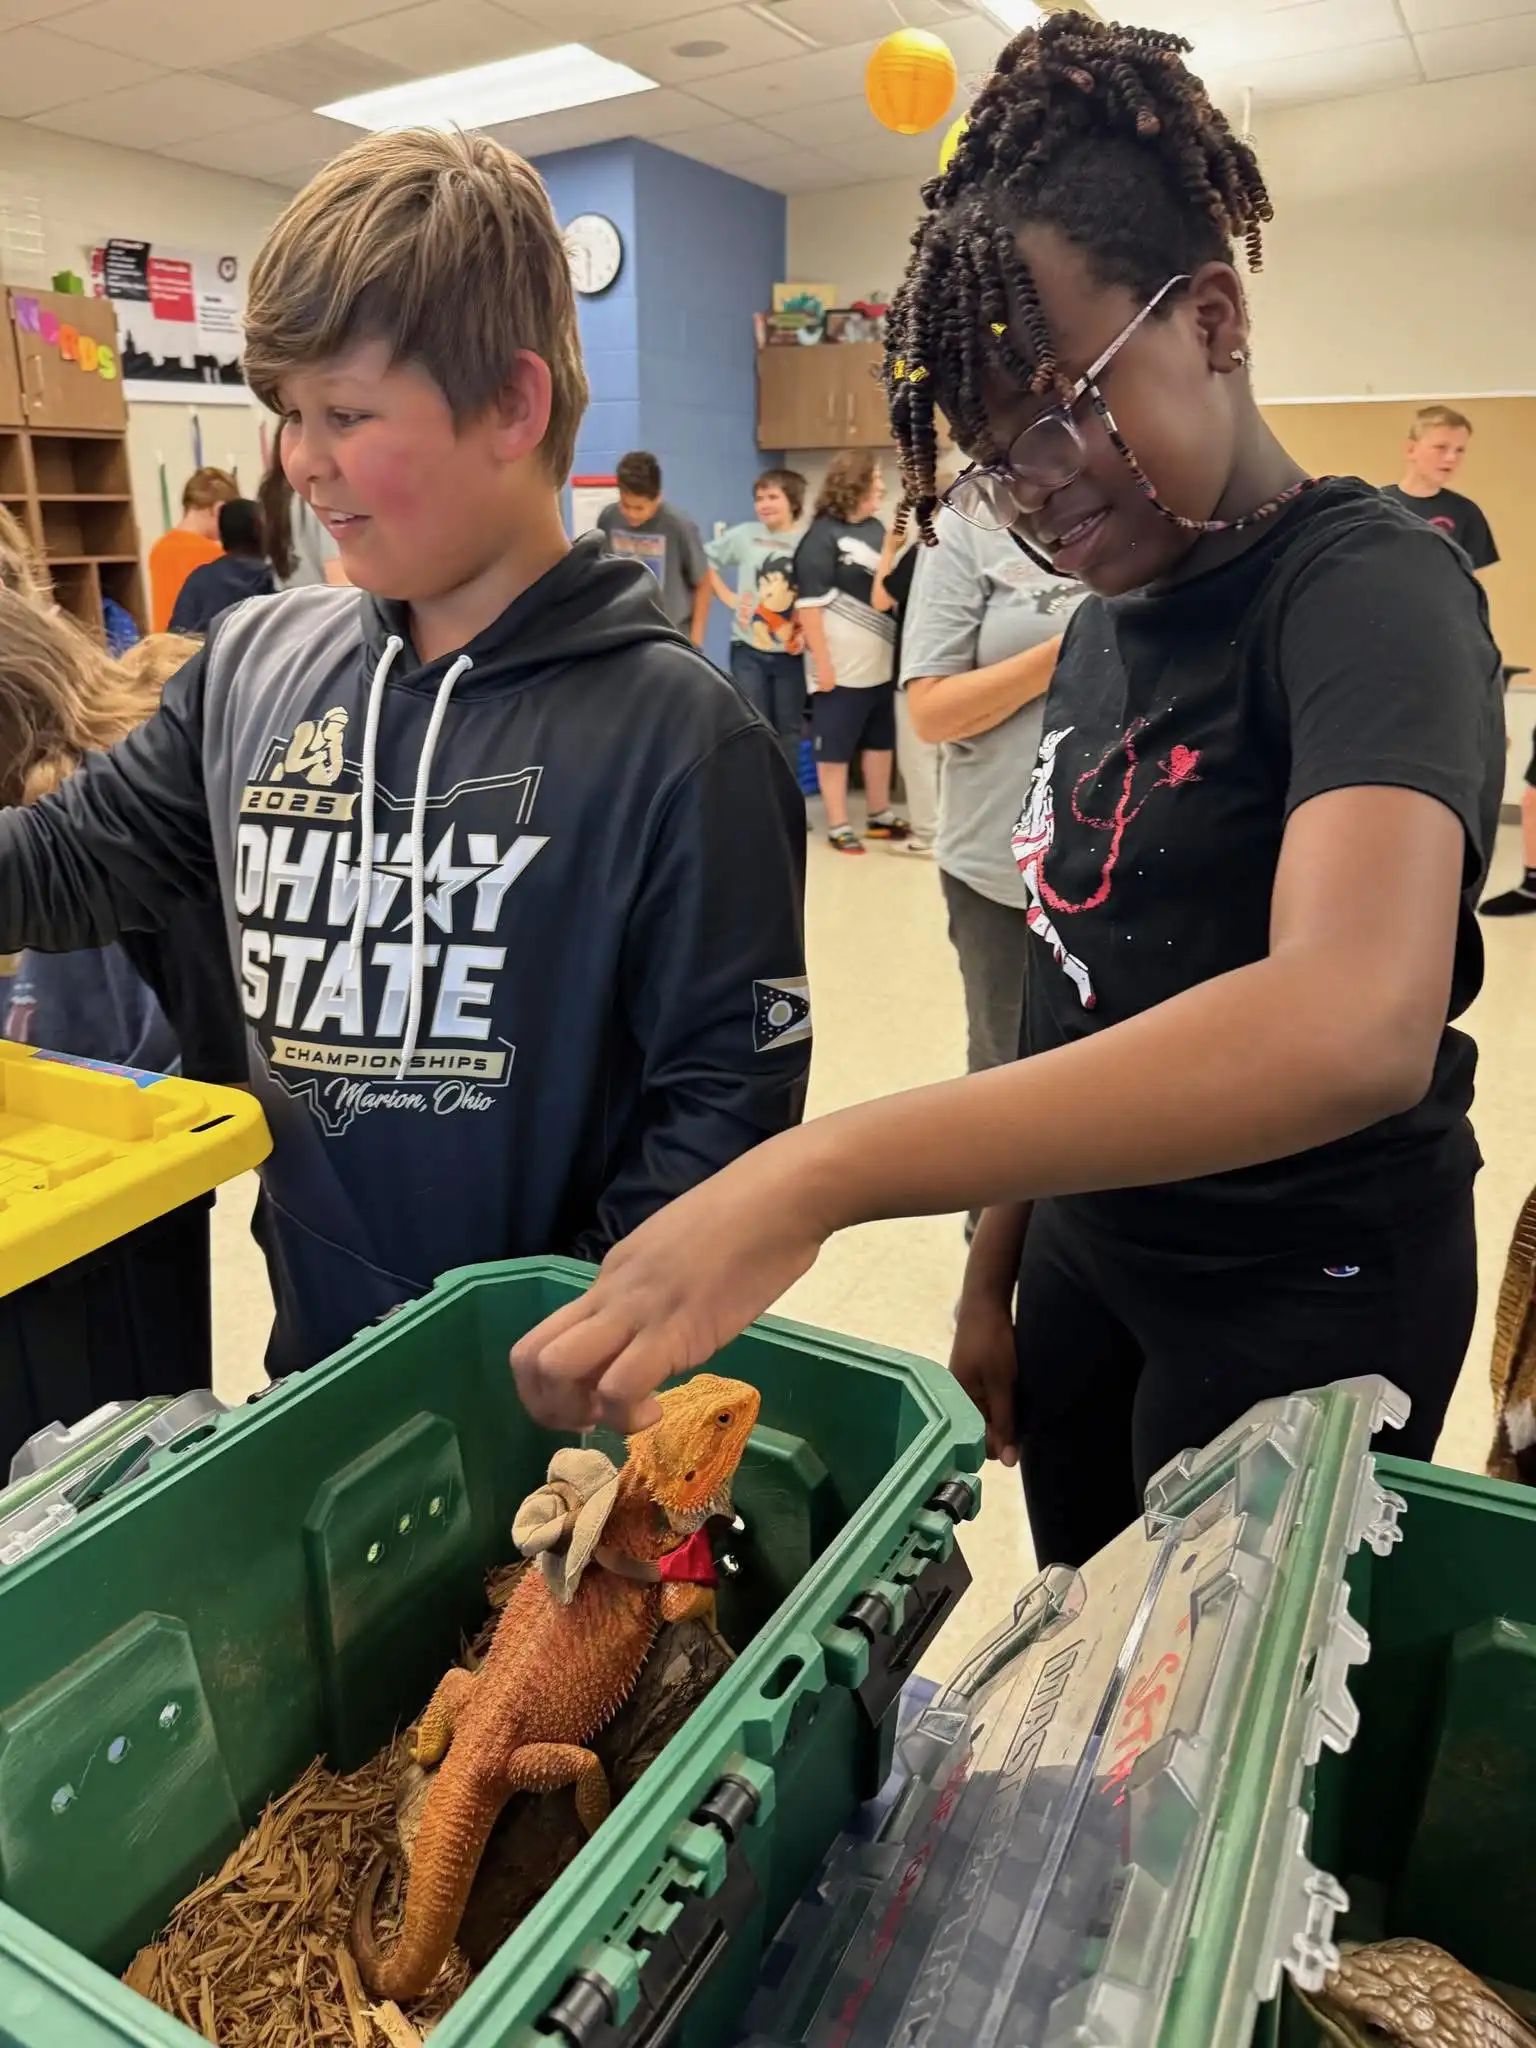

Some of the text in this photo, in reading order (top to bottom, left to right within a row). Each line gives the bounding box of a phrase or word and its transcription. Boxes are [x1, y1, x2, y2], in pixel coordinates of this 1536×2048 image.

[247, 791, 337, 815] 2025
[241, 928, 508, 1040] STATE
[285, 1046, 488, 1072] CHAMPIONSHIPS
[324, 1077, 497, 1115] Marion, Ohio
